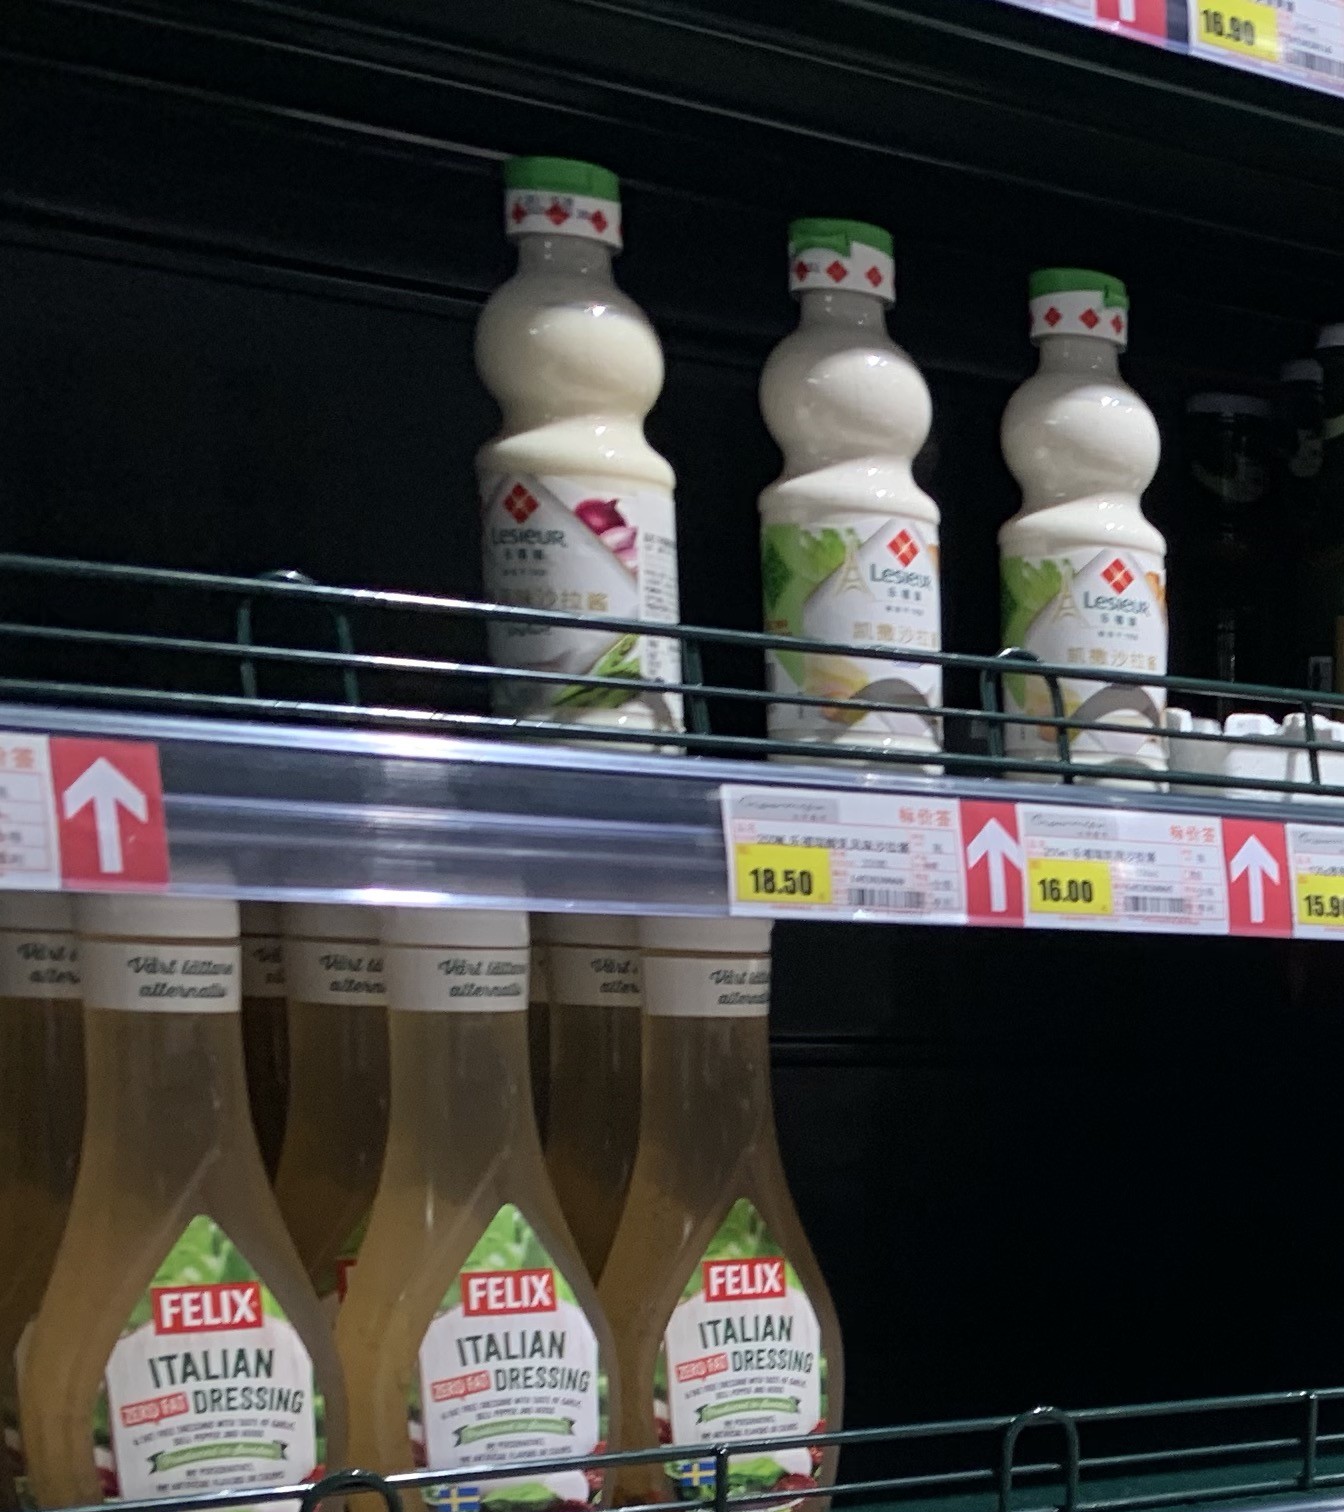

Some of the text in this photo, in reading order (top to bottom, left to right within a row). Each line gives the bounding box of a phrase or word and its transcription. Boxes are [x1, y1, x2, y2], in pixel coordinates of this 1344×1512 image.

[749, 867, 814, 896] 18.50
[1038, 878, 1093, 903] 16.00
[468, 1274, 553, 1311] FELIX
[709, 1262, 784, 1298] FELIX
[160, 1288, 257, 1328] FELIX
[456, 1330, 567, 1367] ITALIAN
[698, 1316, 794, 1350] ITALIAN
[148, 1348, 275, 1389] ITALIAN
[731, 1350, 815, 1374] DRESSING
[494, 1368, 591, 1393] DRESSING
[193, 1386, 305, 1414] DRESSING
